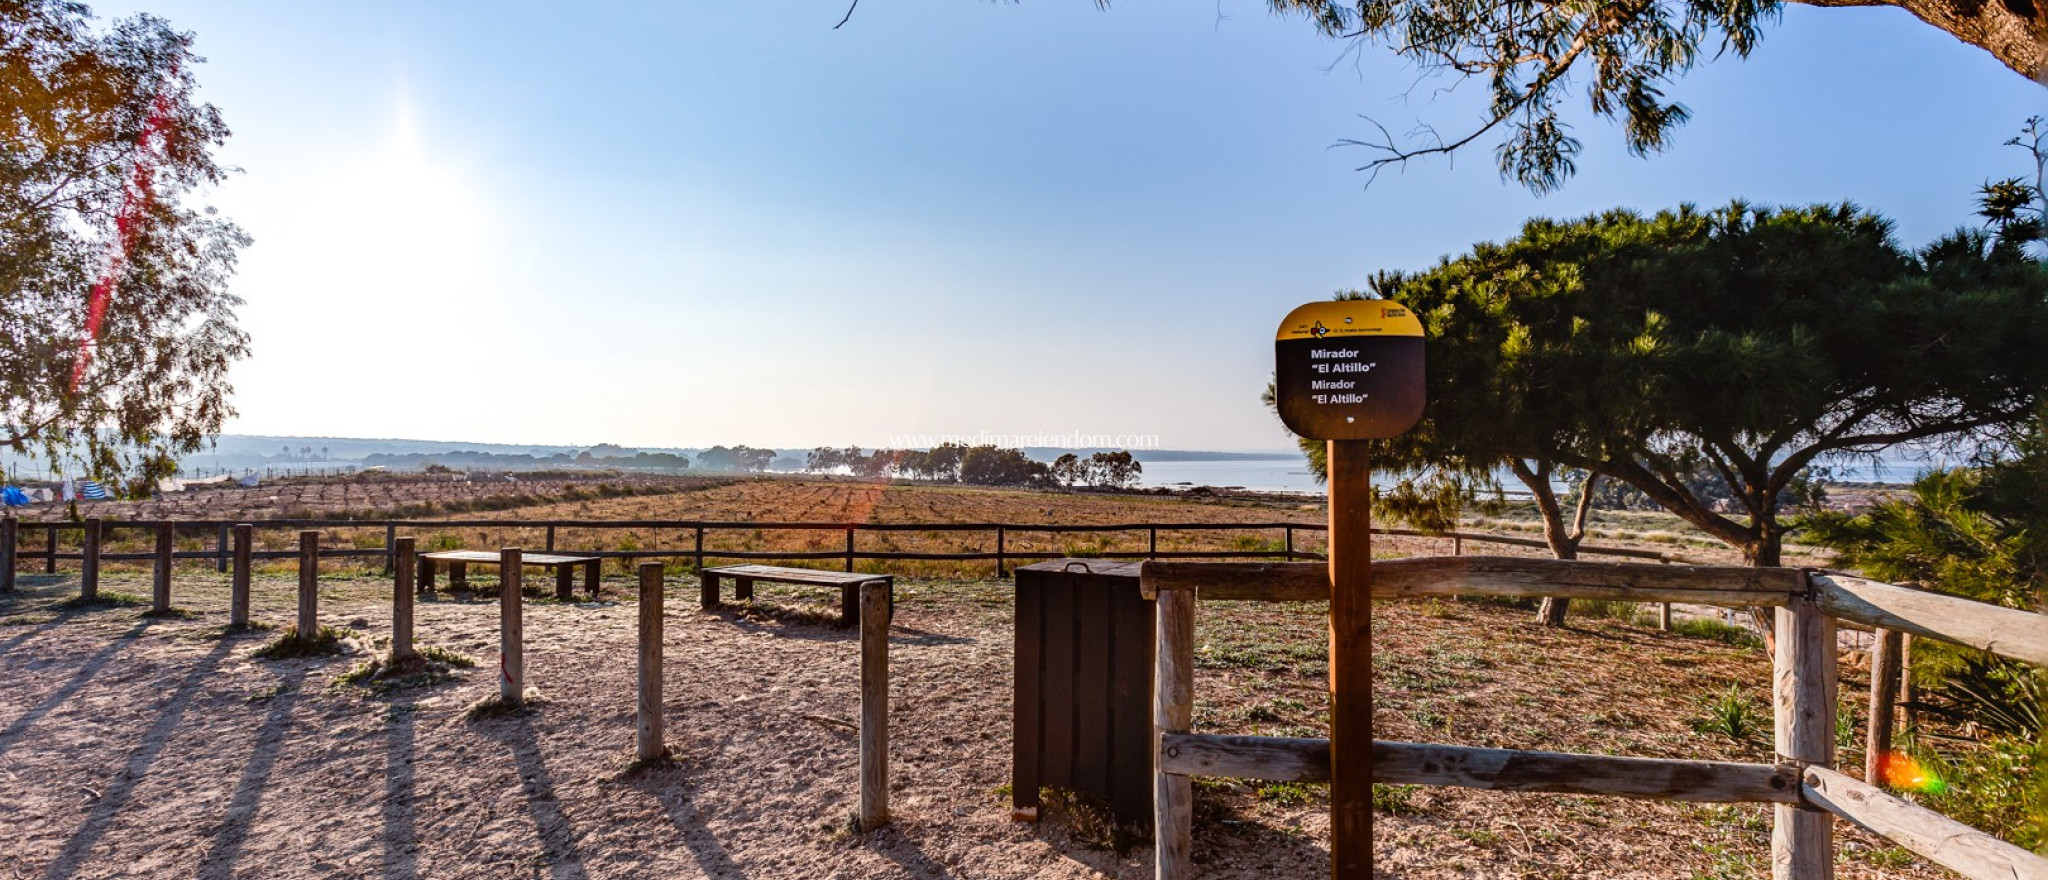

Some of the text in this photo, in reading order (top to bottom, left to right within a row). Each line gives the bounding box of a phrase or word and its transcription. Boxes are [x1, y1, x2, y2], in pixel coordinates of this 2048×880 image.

[1311, 348, 1359, 359] Mirador
[1311, 362, 1376, 373] “El Altillo”
[1311, 380, 1355, 389] Mirador
[1311, 393, 1368, 404] “El Altillo”
